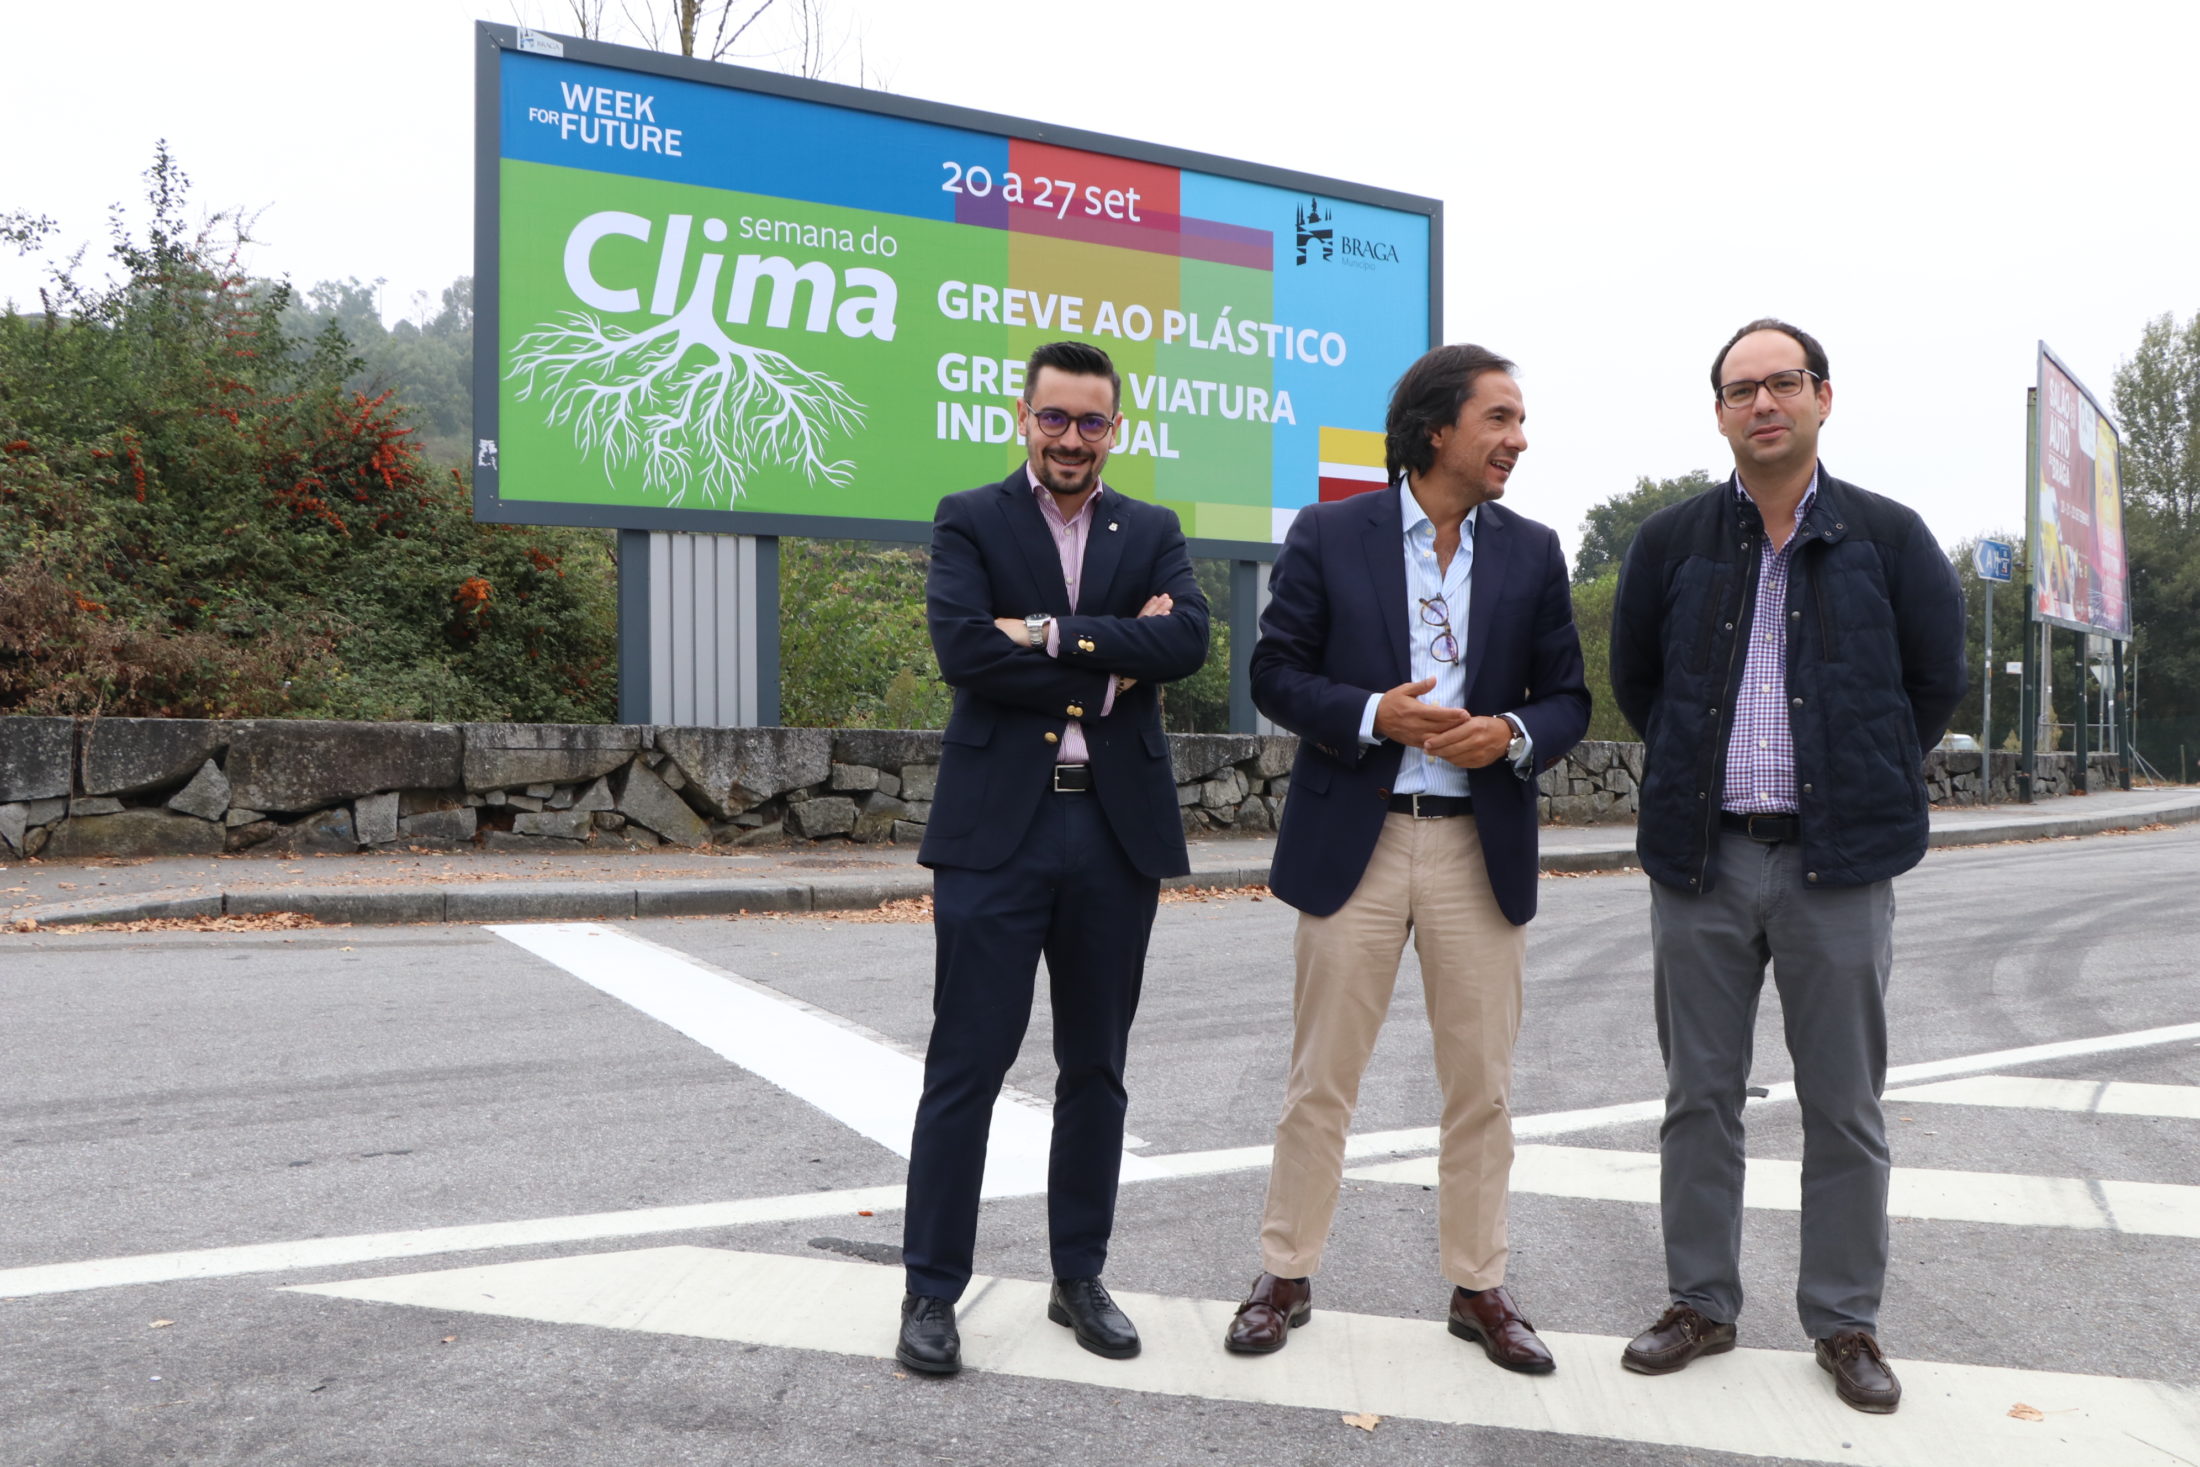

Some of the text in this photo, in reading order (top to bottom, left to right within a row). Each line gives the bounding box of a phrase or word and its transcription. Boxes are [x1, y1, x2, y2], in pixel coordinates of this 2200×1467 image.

[560, 81, 656, 123] WEEK
[528, 107, 683, 157] FOR FUTURE
[941, 161, 1141, 222] 20 a 27 set
[740, 216, 898, 257] semana do
[1341, 235, 1400, 264] BRAGA
[563, 210, 899, 342] Clima
[936, 280, 1348, 367] GREVE AO PLÁSTICO
[936, 352, 1297, 425] GRE VIATURA
[936, 400, 1181, 459] INDUAL
[2048, 415, 2070, 459] AUTO
